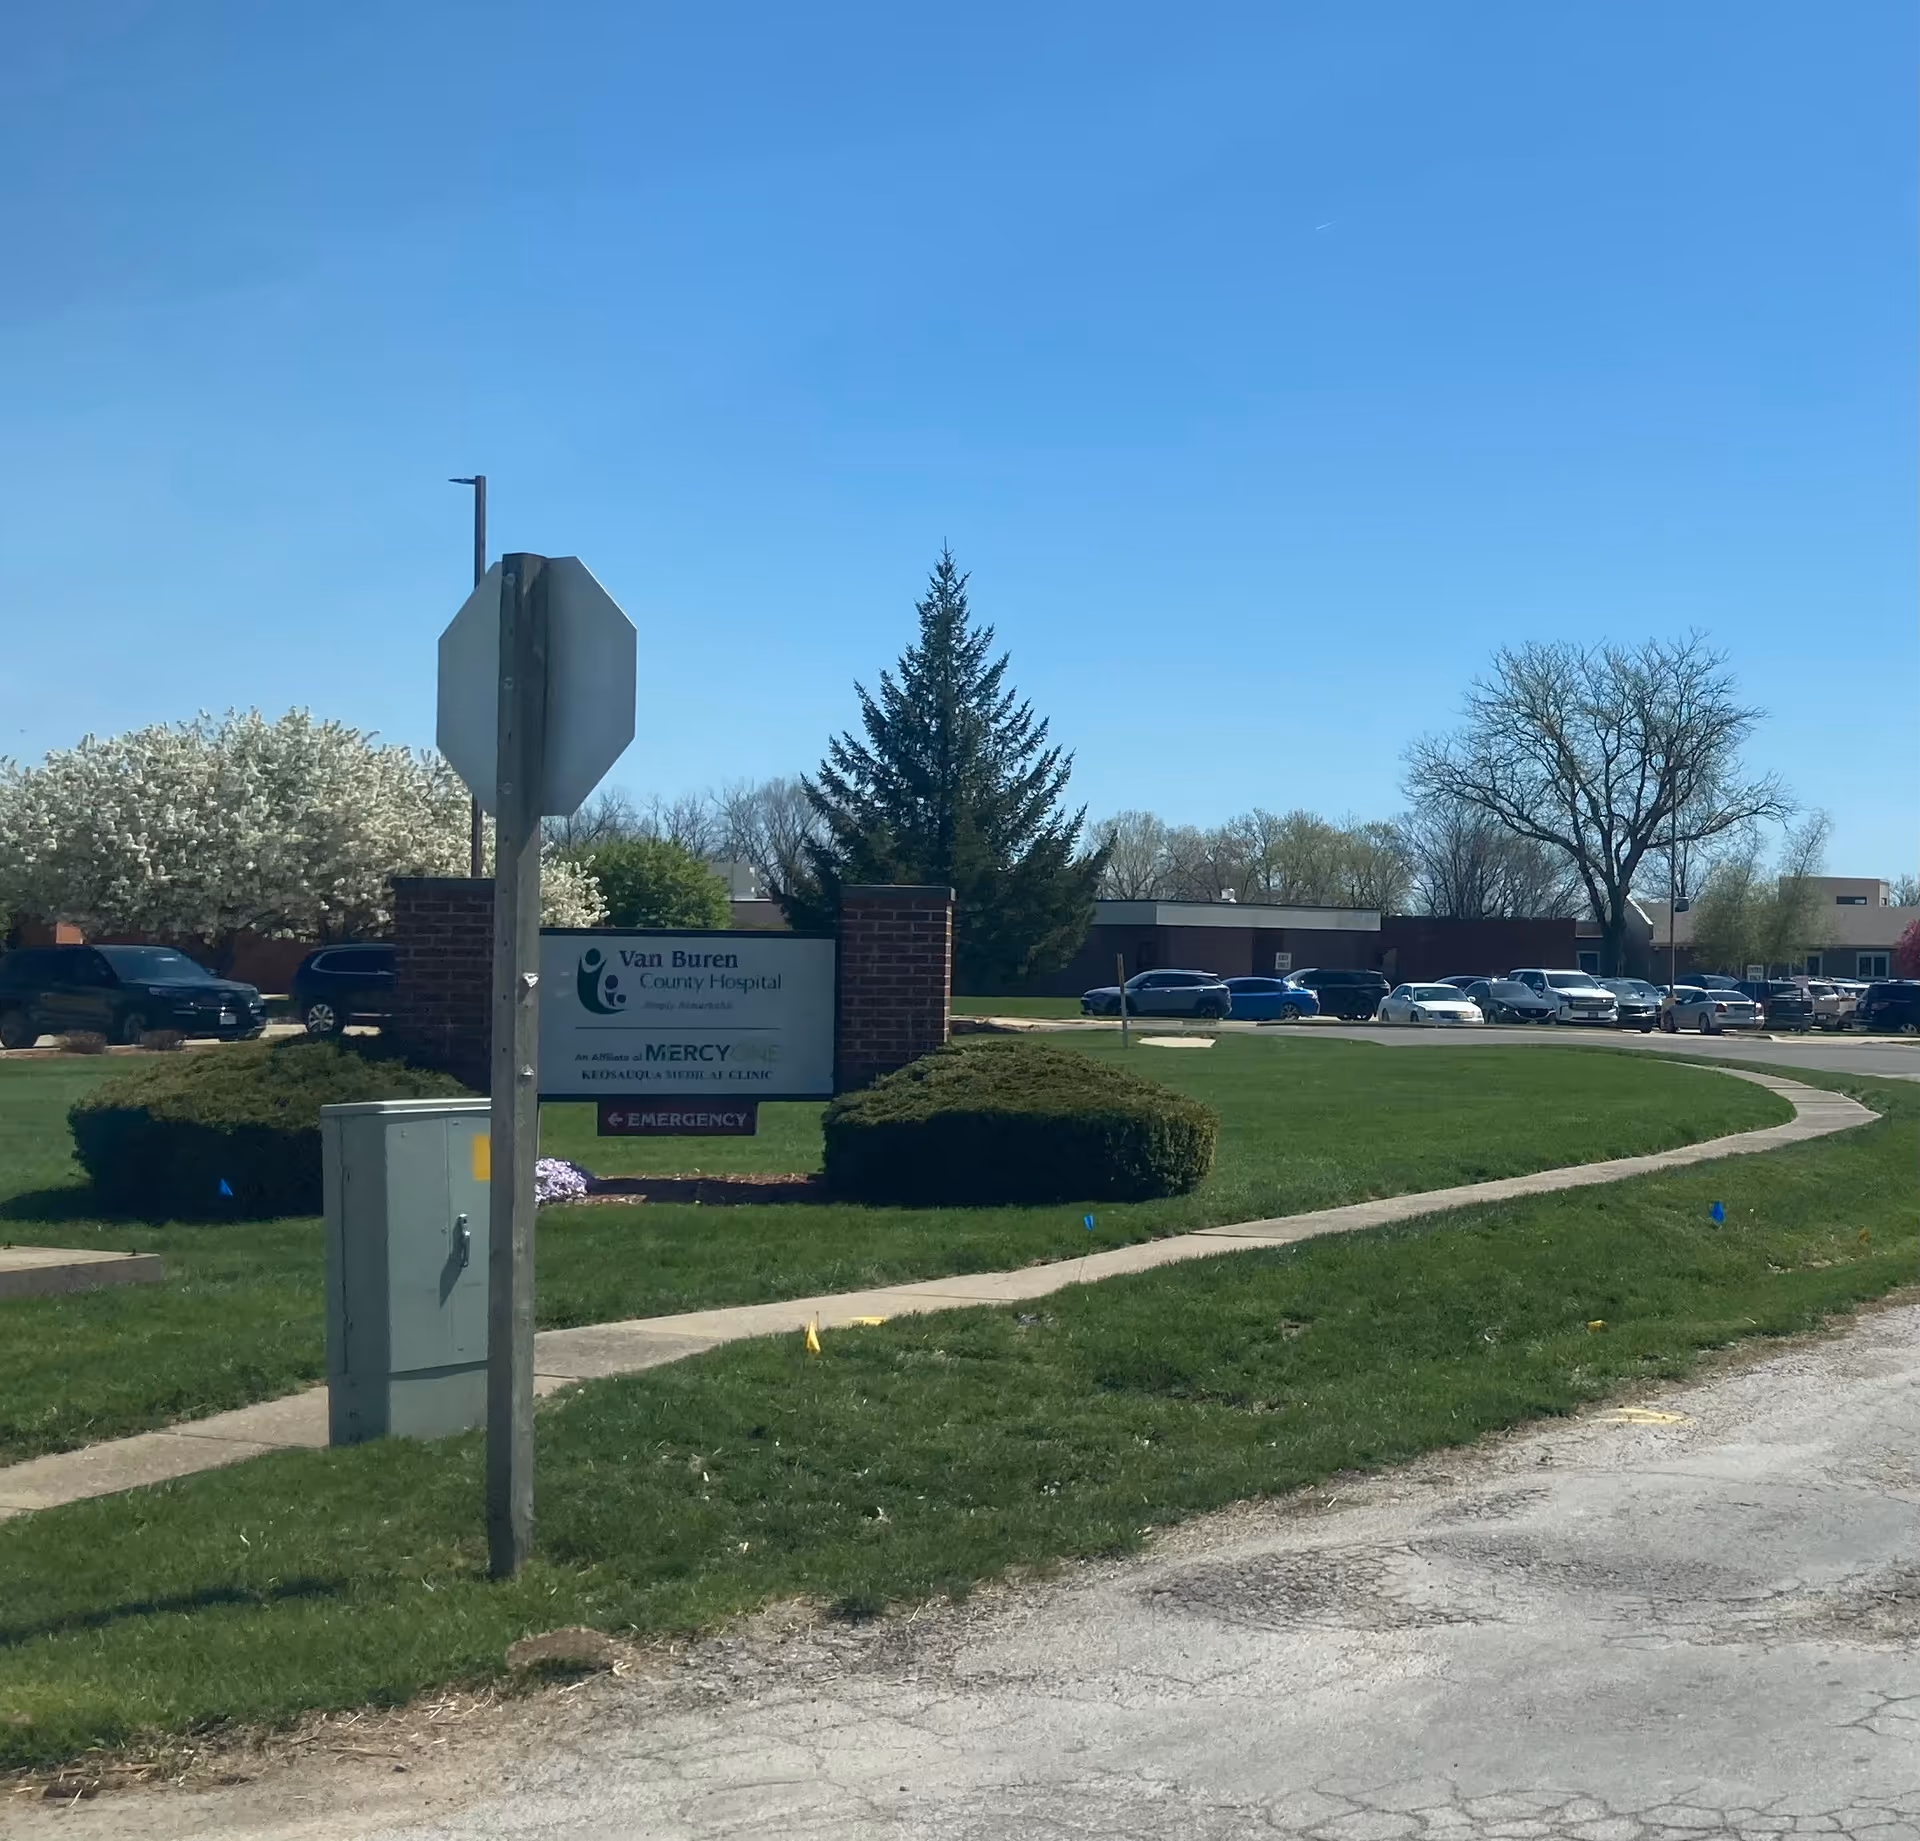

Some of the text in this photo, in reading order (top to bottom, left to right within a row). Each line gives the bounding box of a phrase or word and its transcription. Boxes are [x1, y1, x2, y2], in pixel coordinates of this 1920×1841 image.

[619, 950, 739, 969] Van Buren
[640, 973, 781, 994] County Hospital
[575, 1053, 588, 1061] An
[592, 1053, 630, 1061] Affiliate
[729, 1070, 773, 1080] CLINIC
[627, 1113, 748, 1127] EMERGENCY
